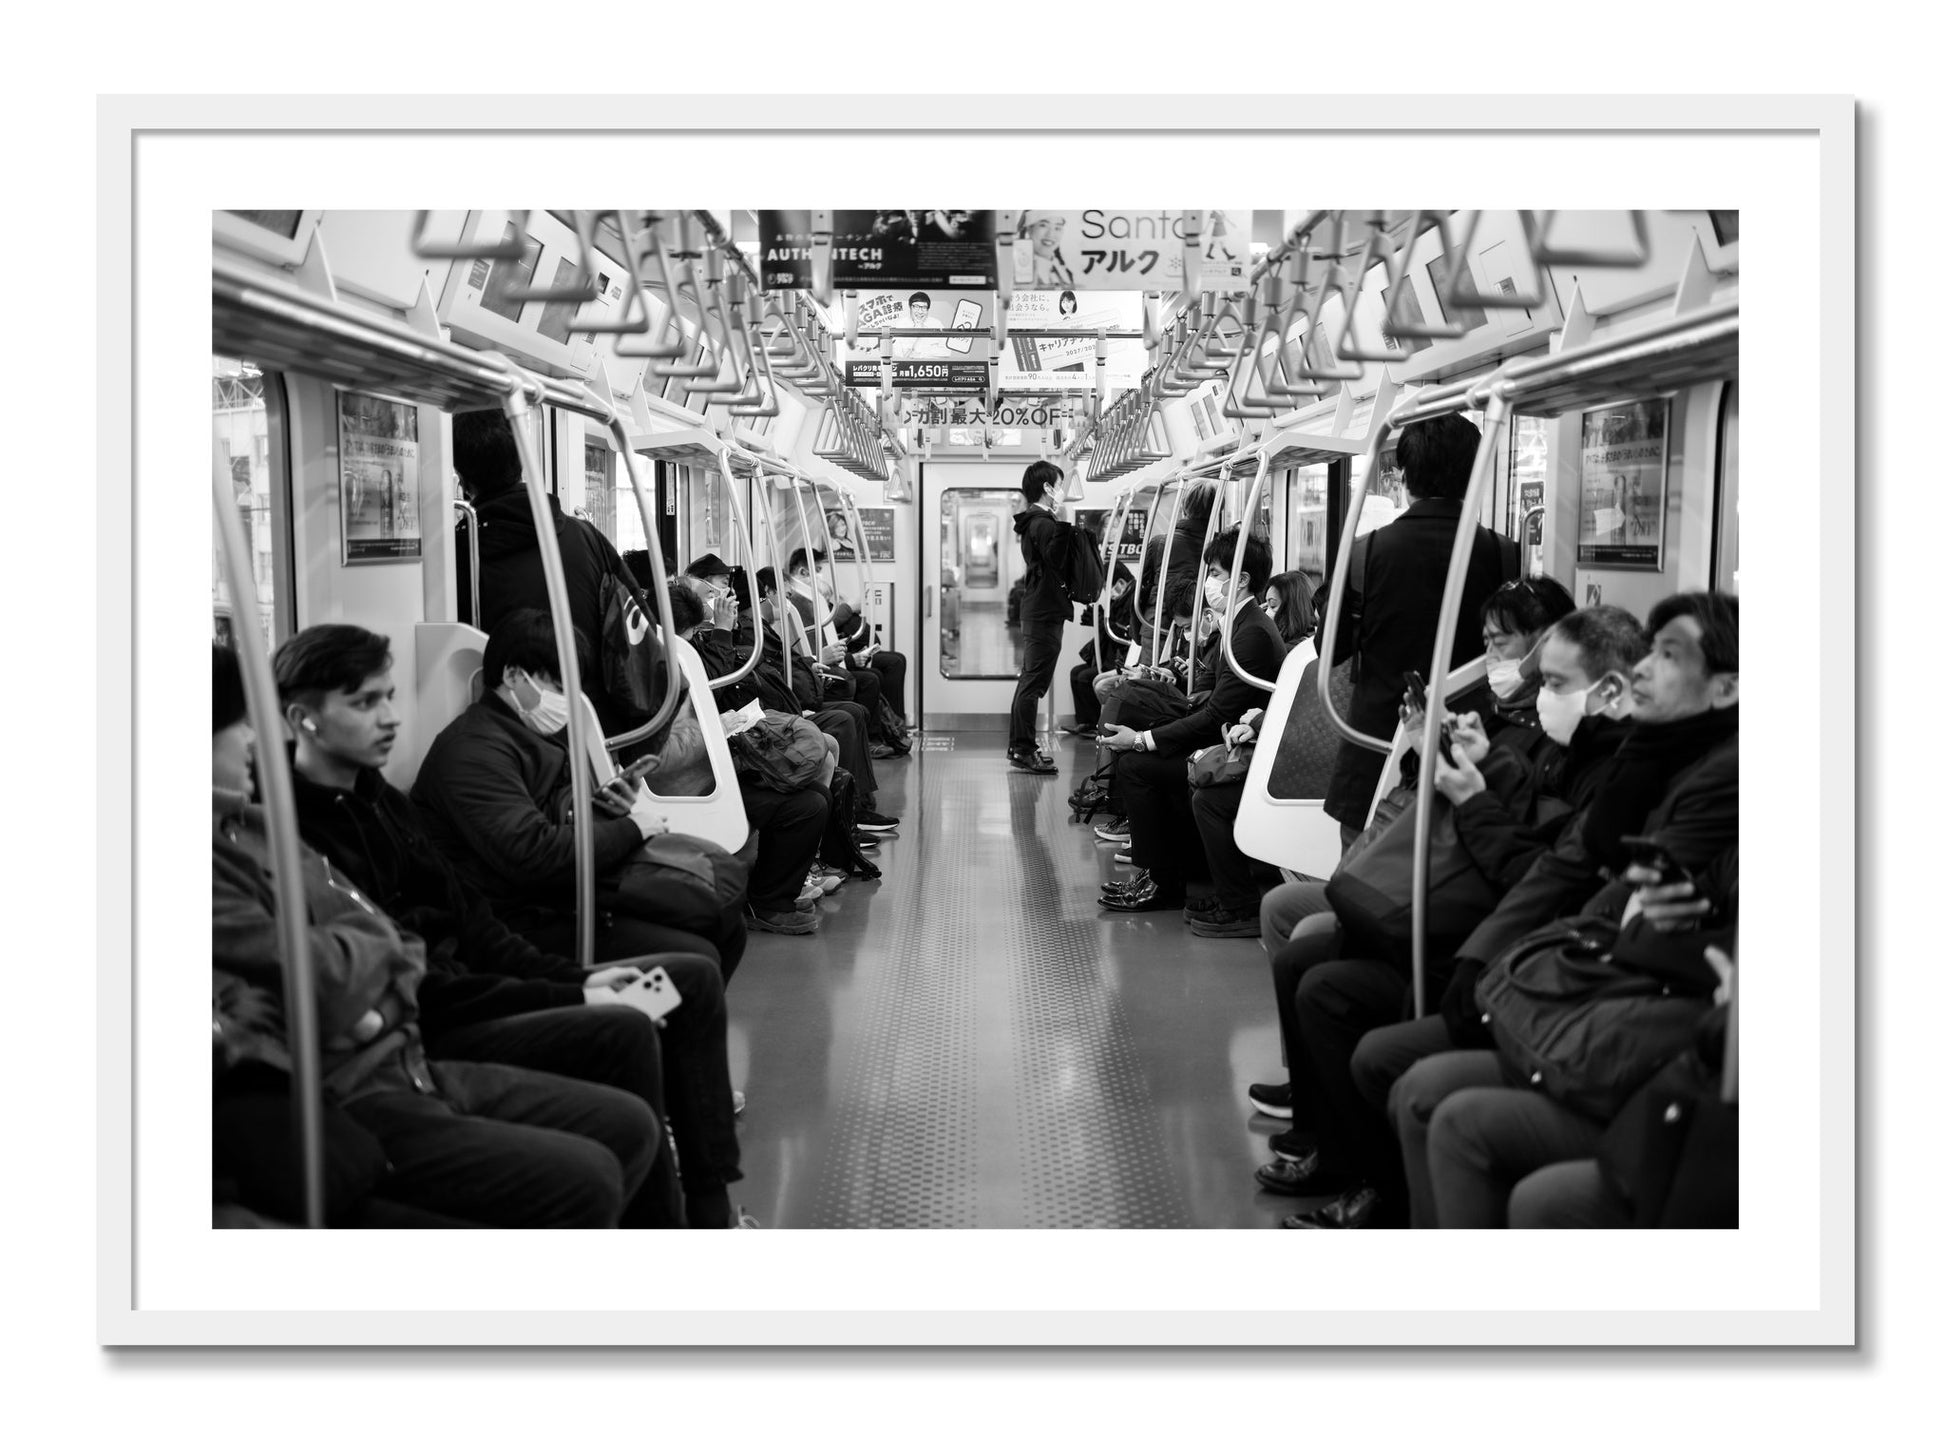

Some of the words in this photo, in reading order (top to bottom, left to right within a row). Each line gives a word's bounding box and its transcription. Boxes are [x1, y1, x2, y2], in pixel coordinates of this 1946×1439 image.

[767, 248, 883, 261] AUTHTECH
[1081, 249, 1160, 275] アルク
